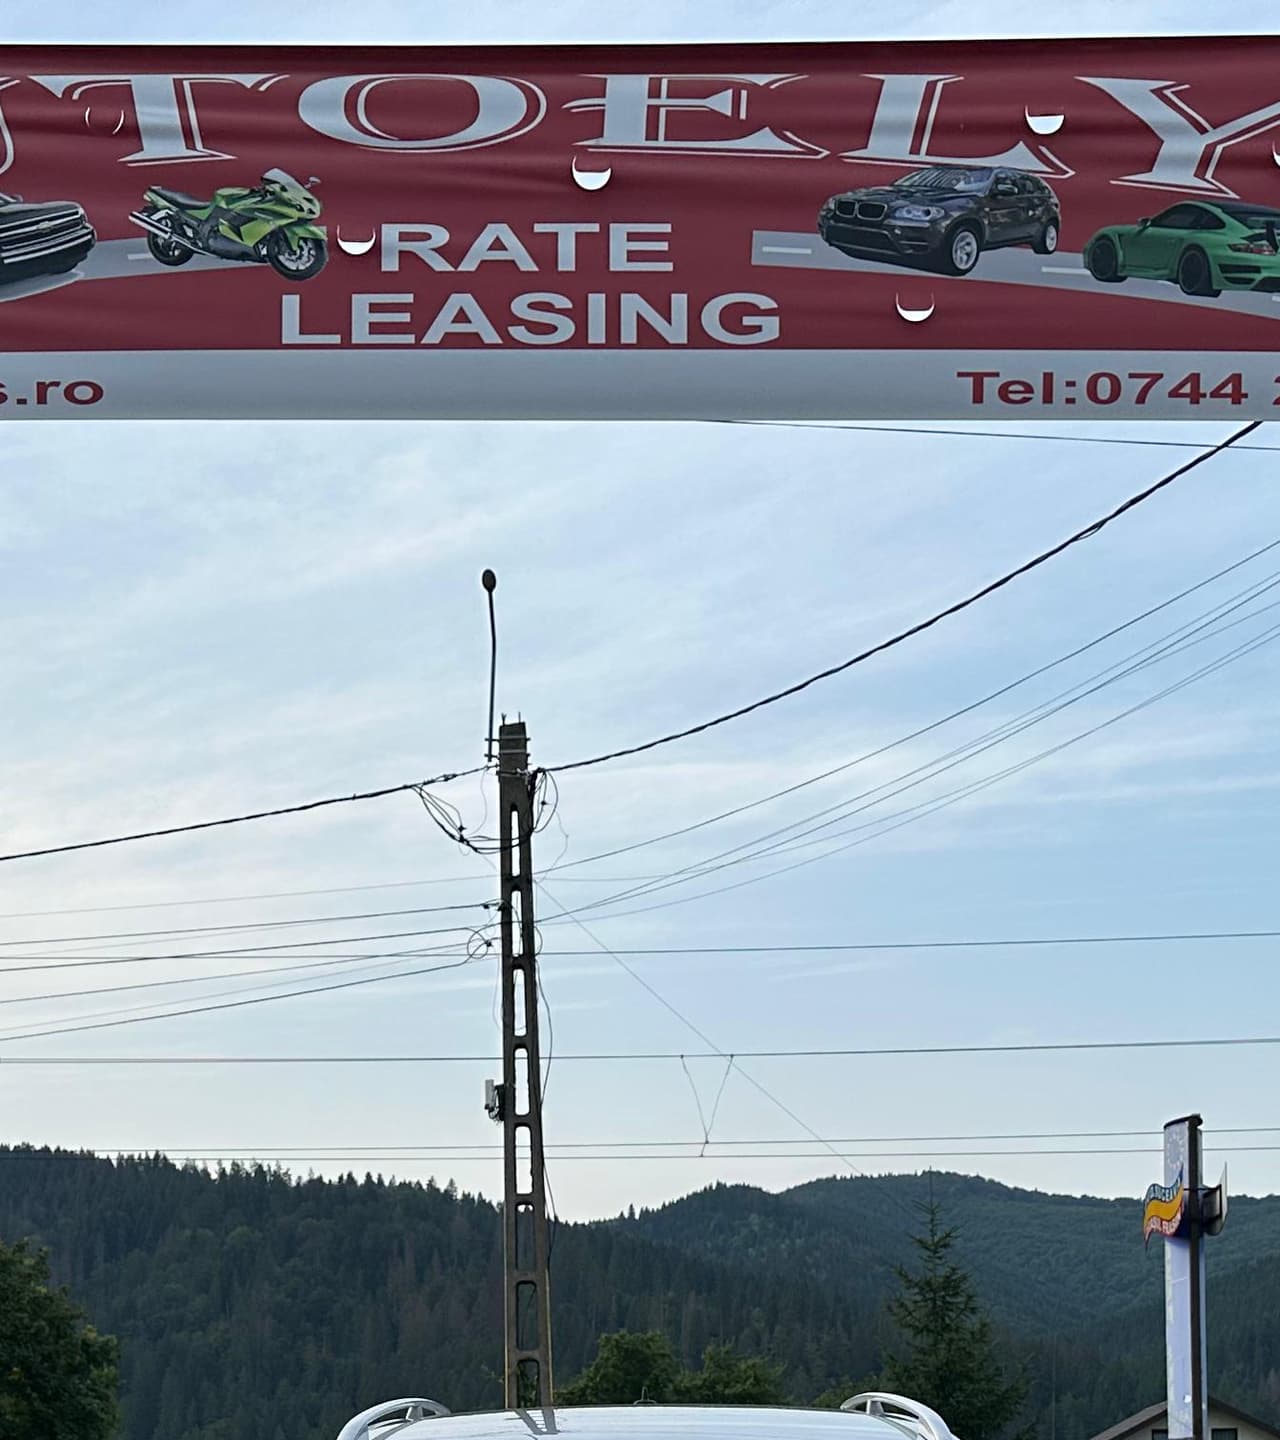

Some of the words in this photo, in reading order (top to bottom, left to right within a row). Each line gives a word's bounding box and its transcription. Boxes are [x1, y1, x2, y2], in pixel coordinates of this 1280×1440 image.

[379, 222, 675, 272] RATE
[281, 292, 781, 345] LEASING
[956, 369, 1249, 406] Tel:0744
